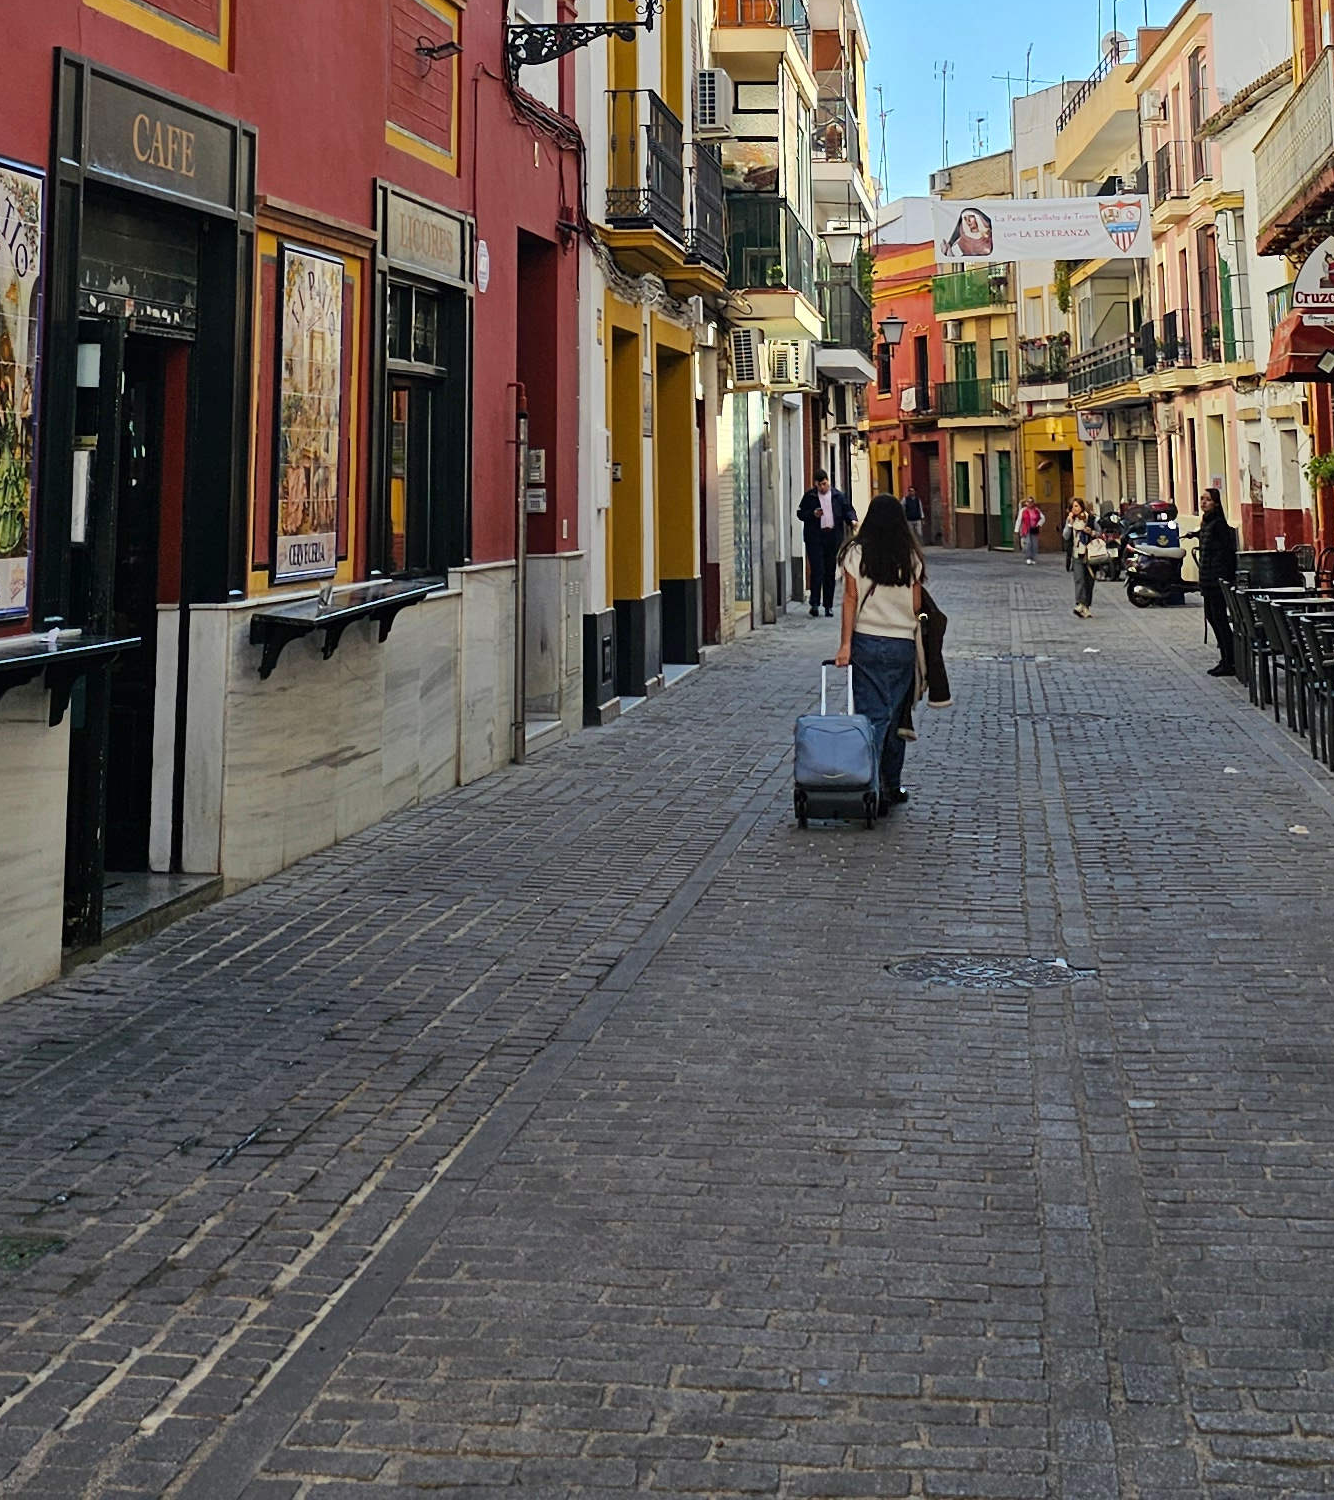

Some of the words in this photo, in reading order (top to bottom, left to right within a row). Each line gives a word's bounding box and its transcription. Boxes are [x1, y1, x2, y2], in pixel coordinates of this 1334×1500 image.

[132, 113, 195, 178] CAFE
[399, 212, 454, 263] LICORES
[1019, 230, 1032, 238] LA
[1034, 228, 1091, 238] ESPERANZA
